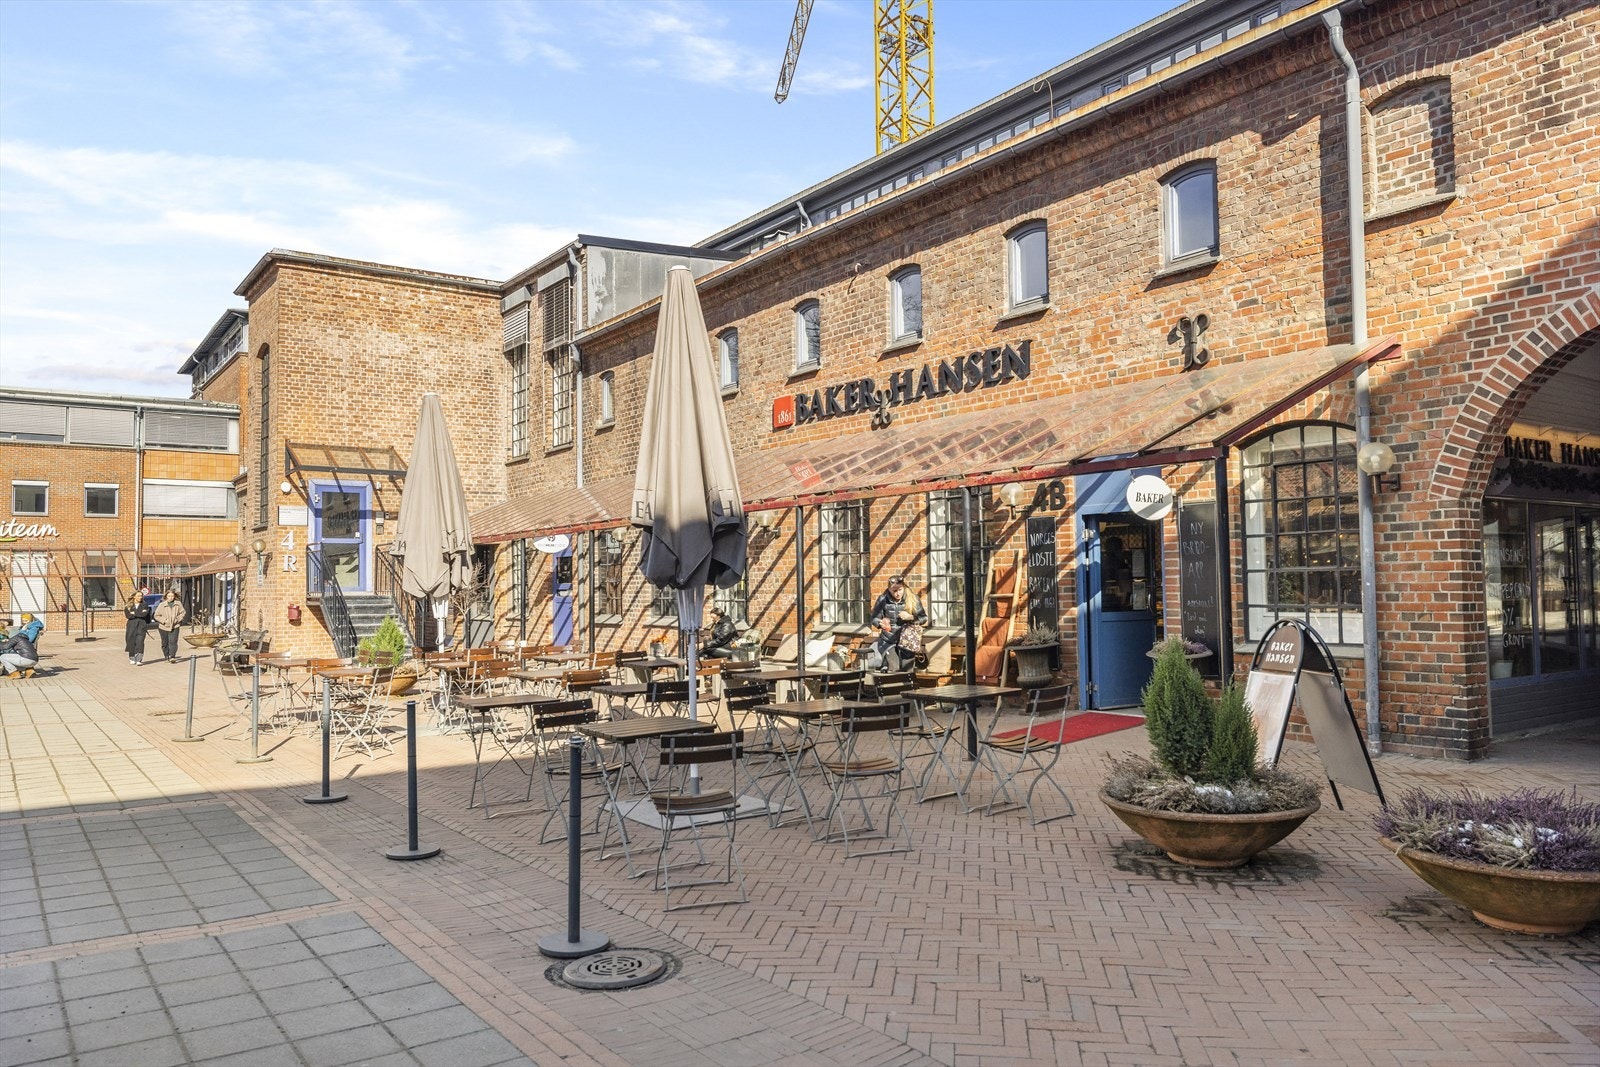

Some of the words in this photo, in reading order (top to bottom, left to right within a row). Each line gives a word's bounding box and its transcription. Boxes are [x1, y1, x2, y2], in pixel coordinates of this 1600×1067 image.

[777, 409, 792, 424] 1861
[794, 377, 876, 424] BAKER
[889, 339, 1032, 404] HANSEN
[1504, 436, 1554, 462] BAKER
[1033, 480, 1066, 512] 4B
[1135, 491, 1164, 504] BAKER
[281, 530, 295, 551] 4
[283, 555, 297, 572] R
